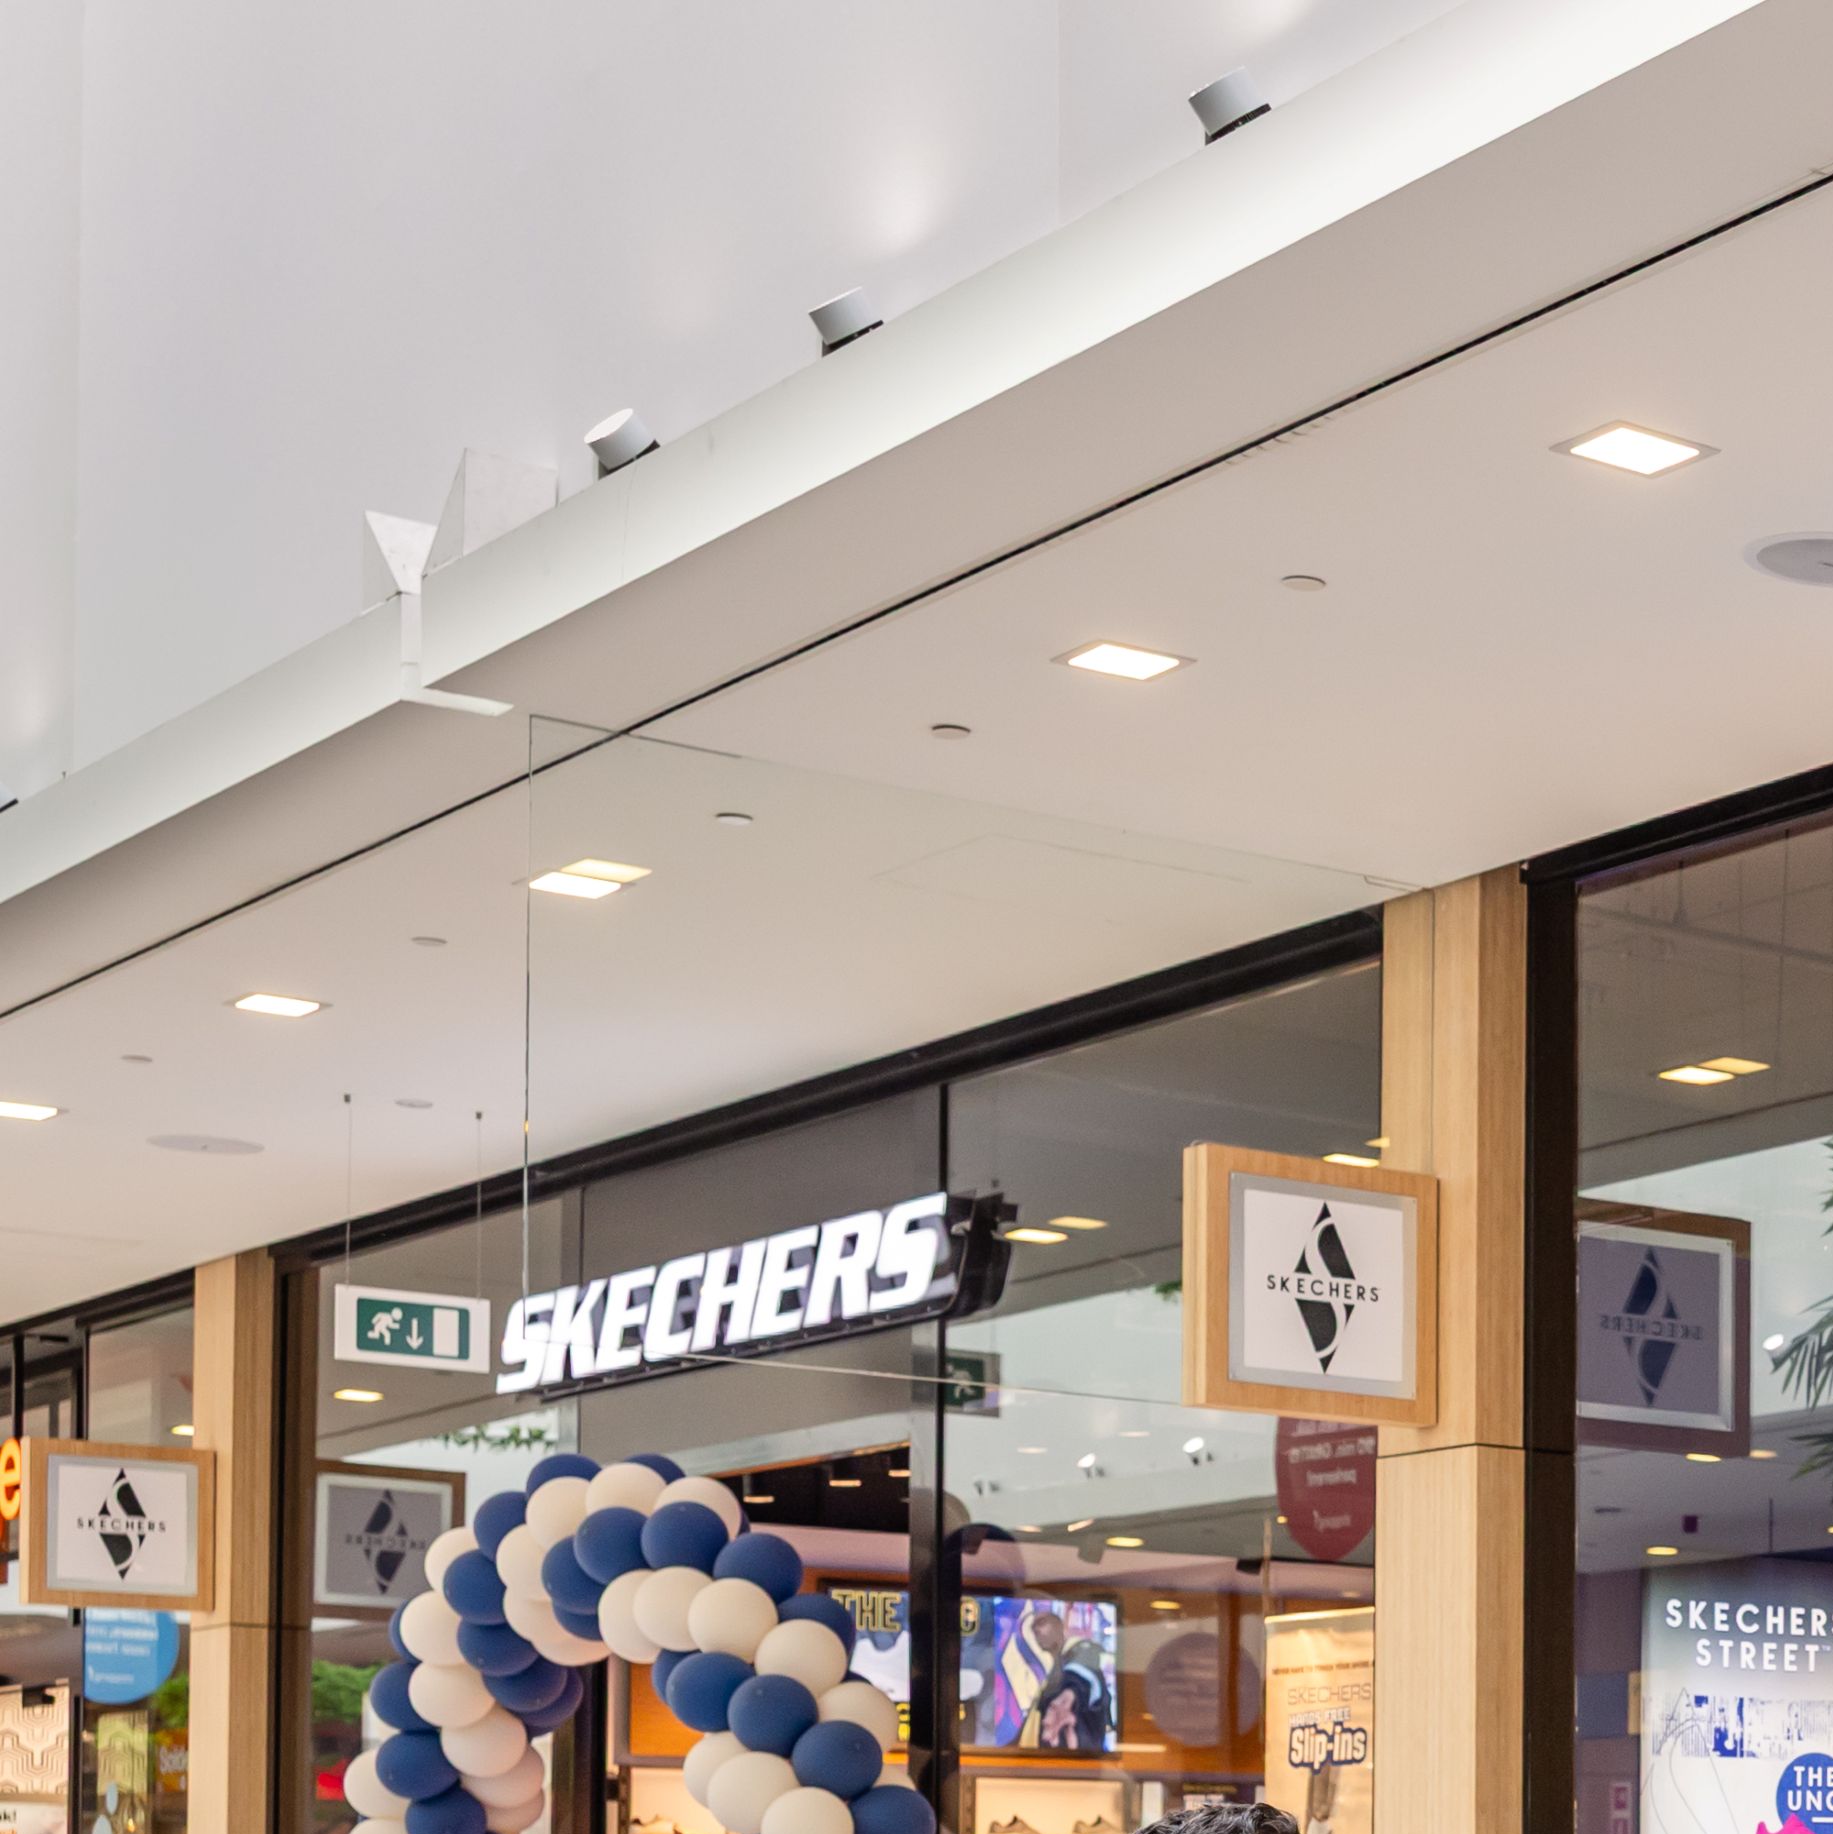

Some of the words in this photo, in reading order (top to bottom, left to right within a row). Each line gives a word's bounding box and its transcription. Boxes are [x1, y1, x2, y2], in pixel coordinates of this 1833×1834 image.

[496, 1191, 948, 1394] SKECHERS
[1266, 1273, 1380, 1303] SKECHERS
[76, 1517, 167, 1533] SKECHERS
[1288, 1682, 1372, 1705] SKECHERS
[1290, 1723, 1367, 1771] Slip-ins
